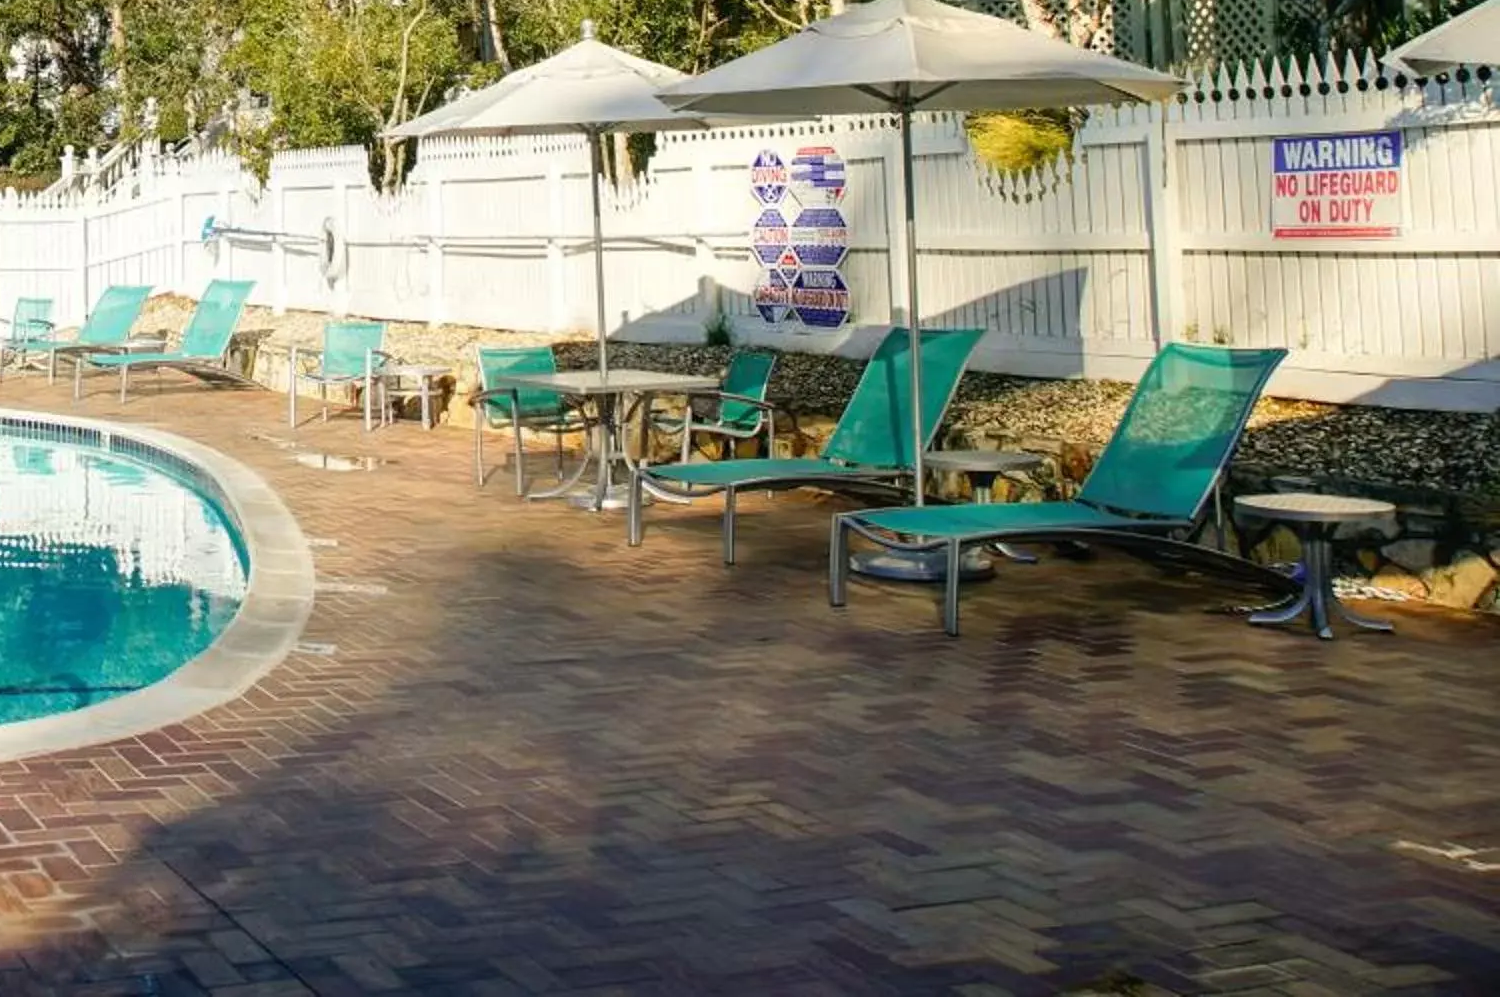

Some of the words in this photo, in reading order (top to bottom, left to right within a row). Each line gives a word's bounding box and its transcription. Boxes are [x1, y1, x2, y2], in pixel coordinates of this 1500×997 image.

[1282, 136, 1393, 170] WARNING
[752, 167, 788, 184] DIVING
[1275, 175, 1299, 197] NO
[1305, 171, 1398, 196] LIFEGUARD
[1300, 200, 1321, 223] ON
[1329, 199, 1375, 222] DUTY
